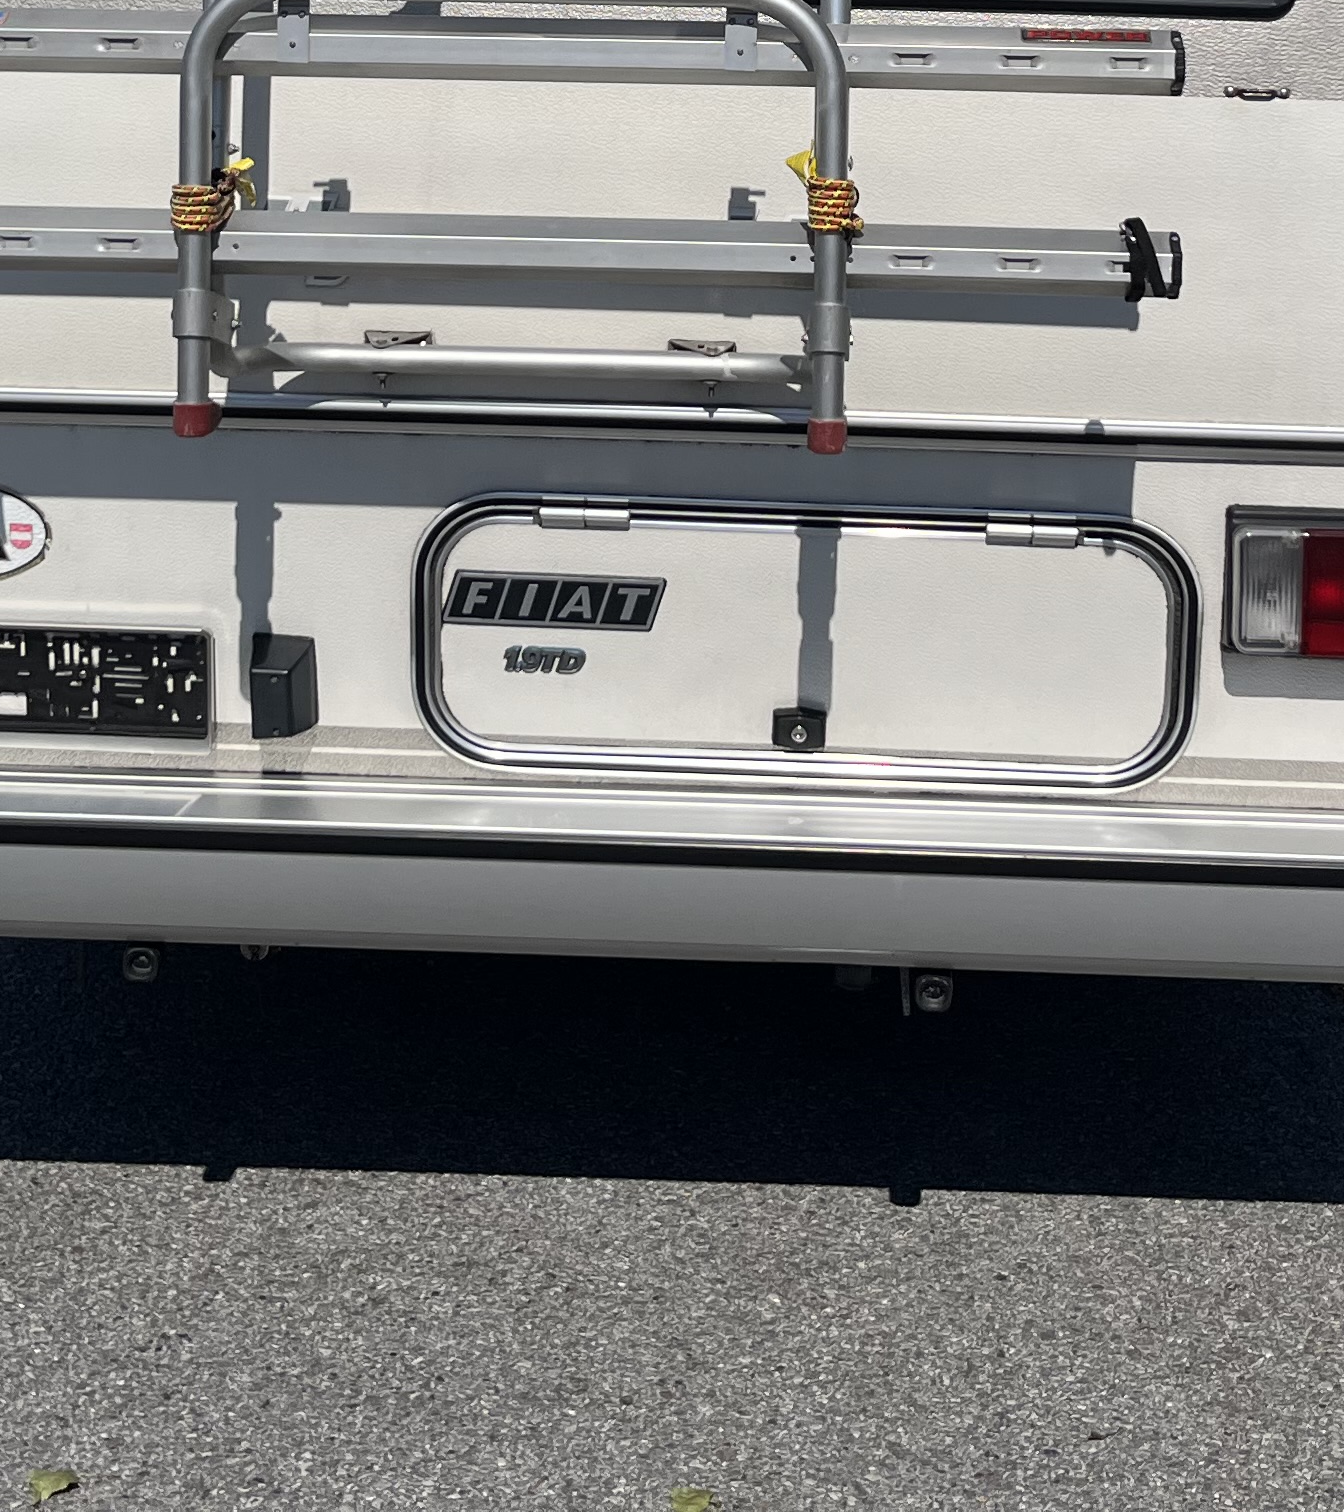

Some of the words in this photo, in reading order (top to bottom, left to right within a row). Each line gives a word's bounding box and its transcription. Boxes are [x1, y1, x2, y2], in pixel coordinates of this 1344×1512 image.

[1026, 29, 1148, 41] POWER
[462, 581, 650, 621] FIAT
[503, 644, 587, 674] 1.9TD
